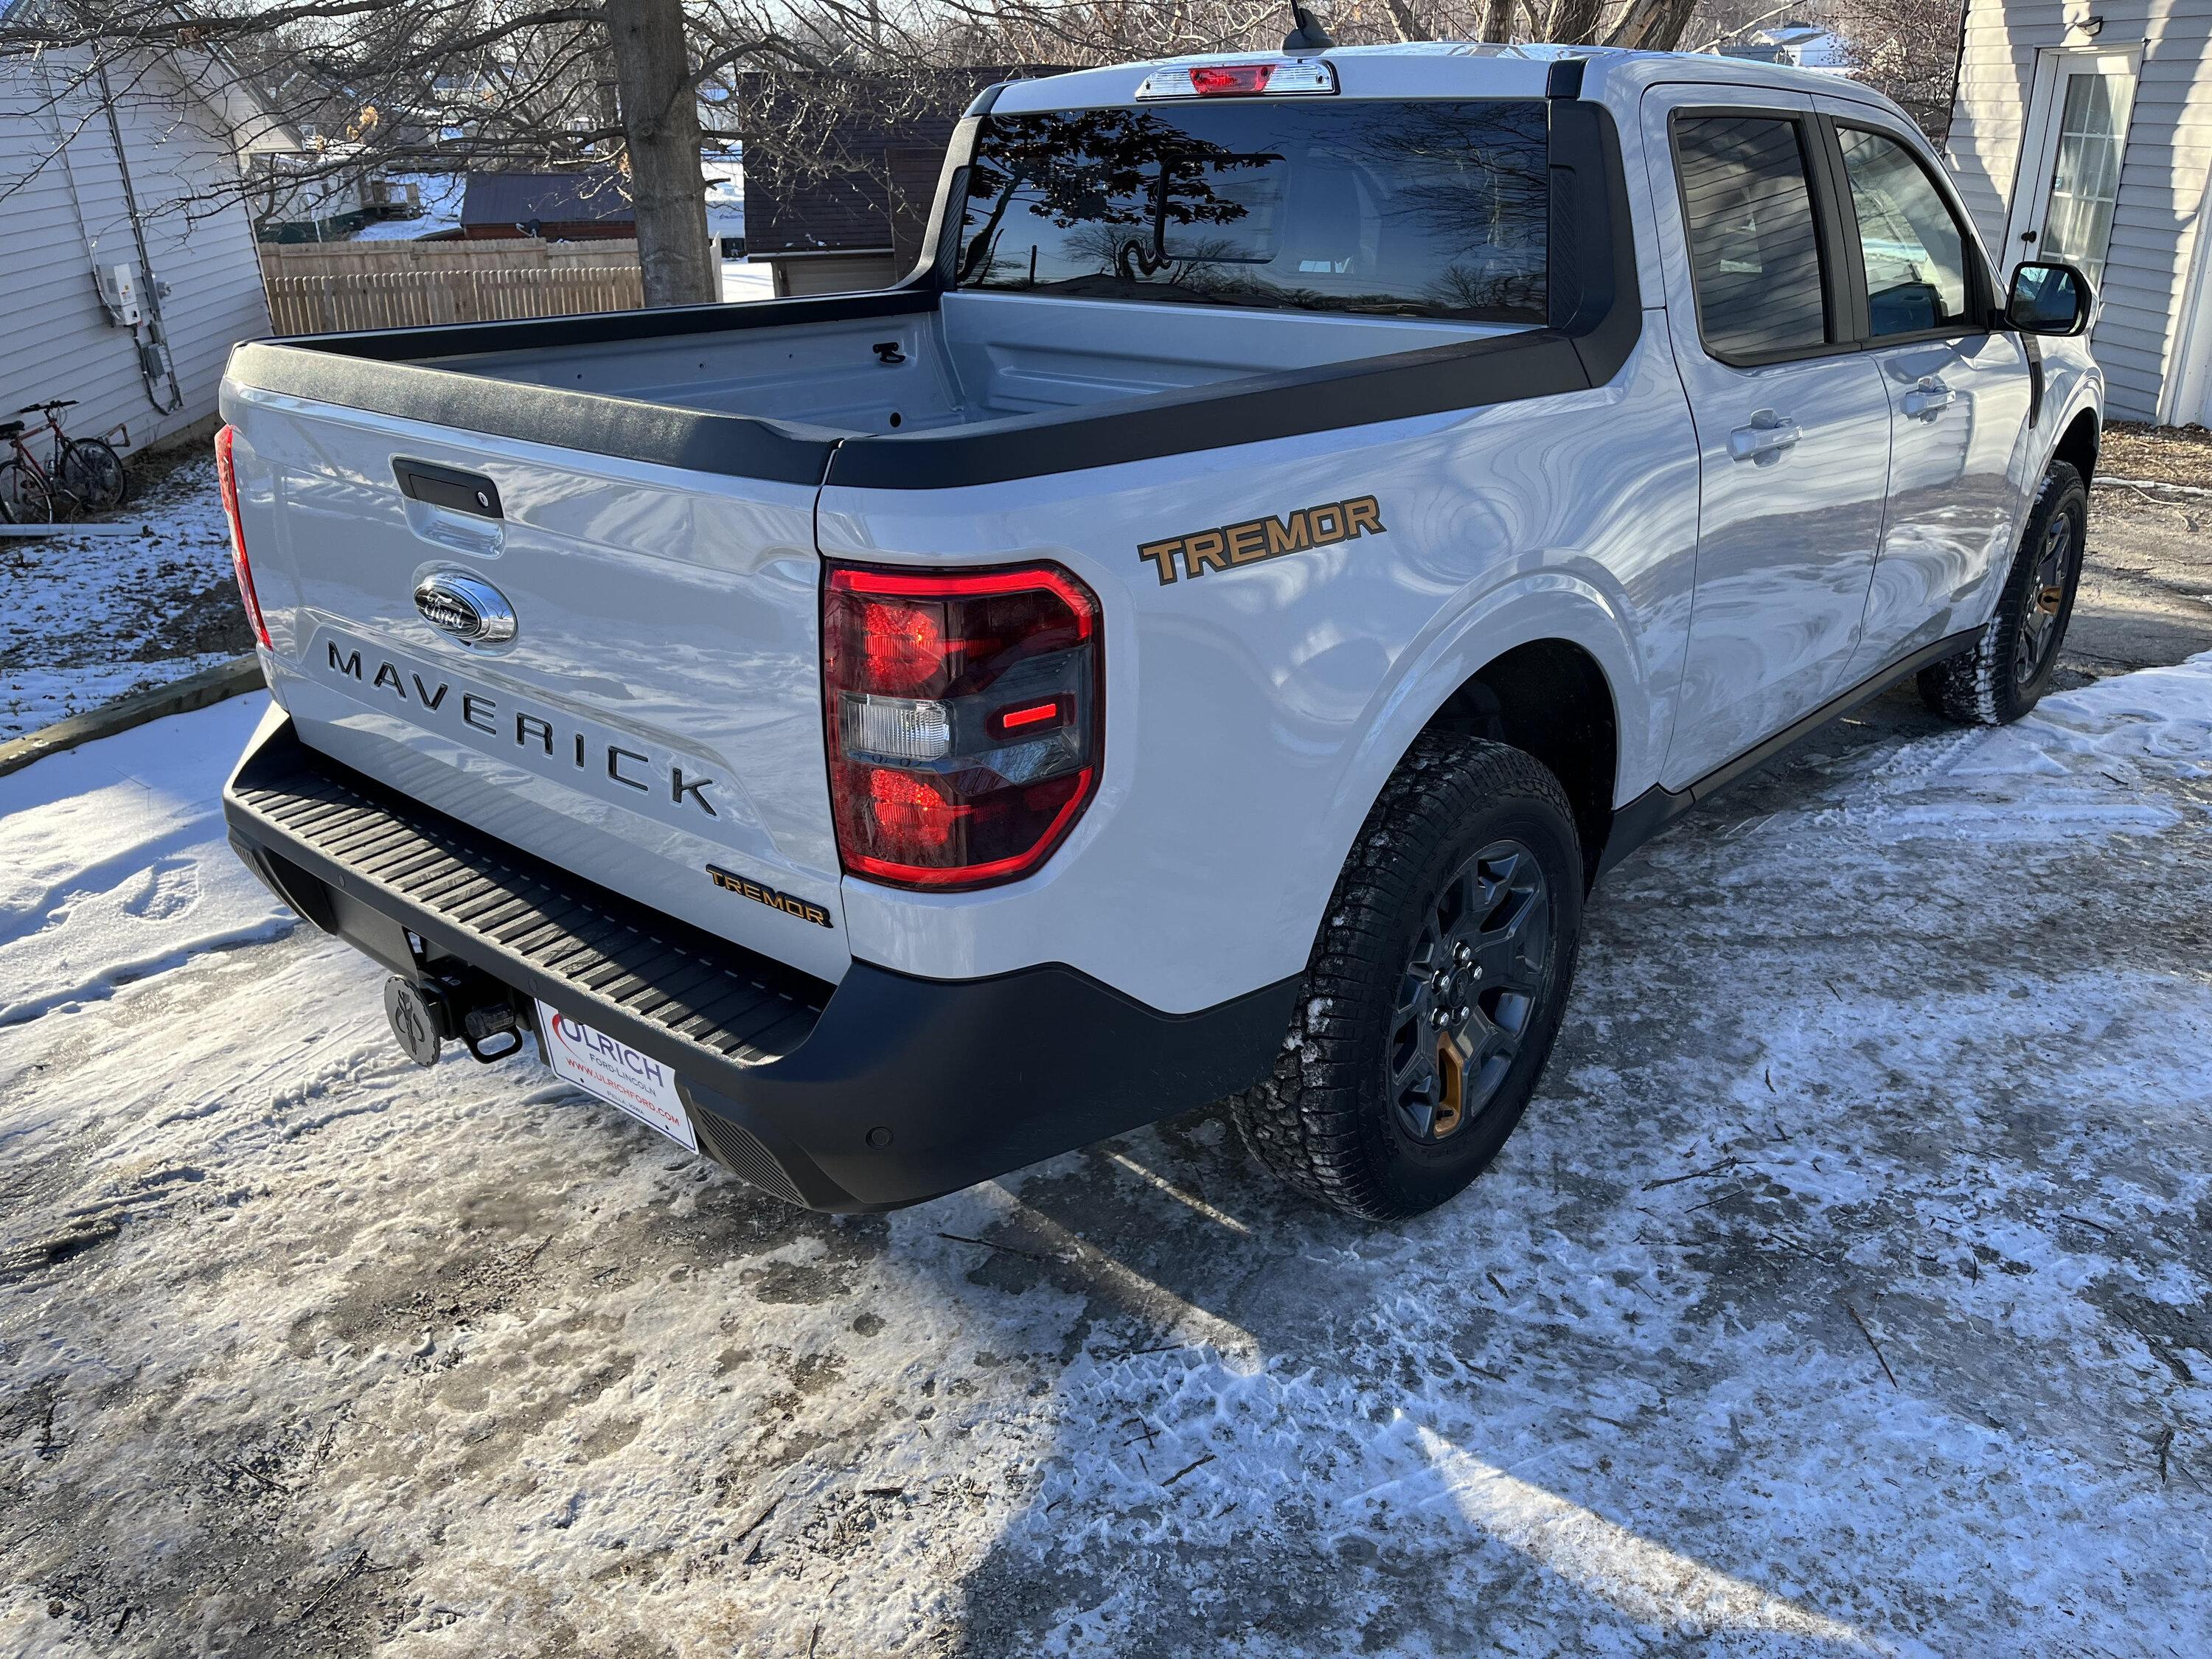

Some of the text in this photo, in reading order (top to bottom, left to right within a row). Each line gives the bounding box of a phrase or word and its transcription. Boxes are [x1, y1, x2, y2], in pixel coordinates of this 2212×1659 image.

[1137, 495, 1387, 585] TREMOR
[424, 591, 465, 629] Ford
[327, 639, 717, 816] MAVERICK
[706, 863, 834, 928] TREMOR
[560, 1015, 664, 1088] ULRICH
[566, 1057, 680, 1126] WWW.ULRICHFORD.COM
